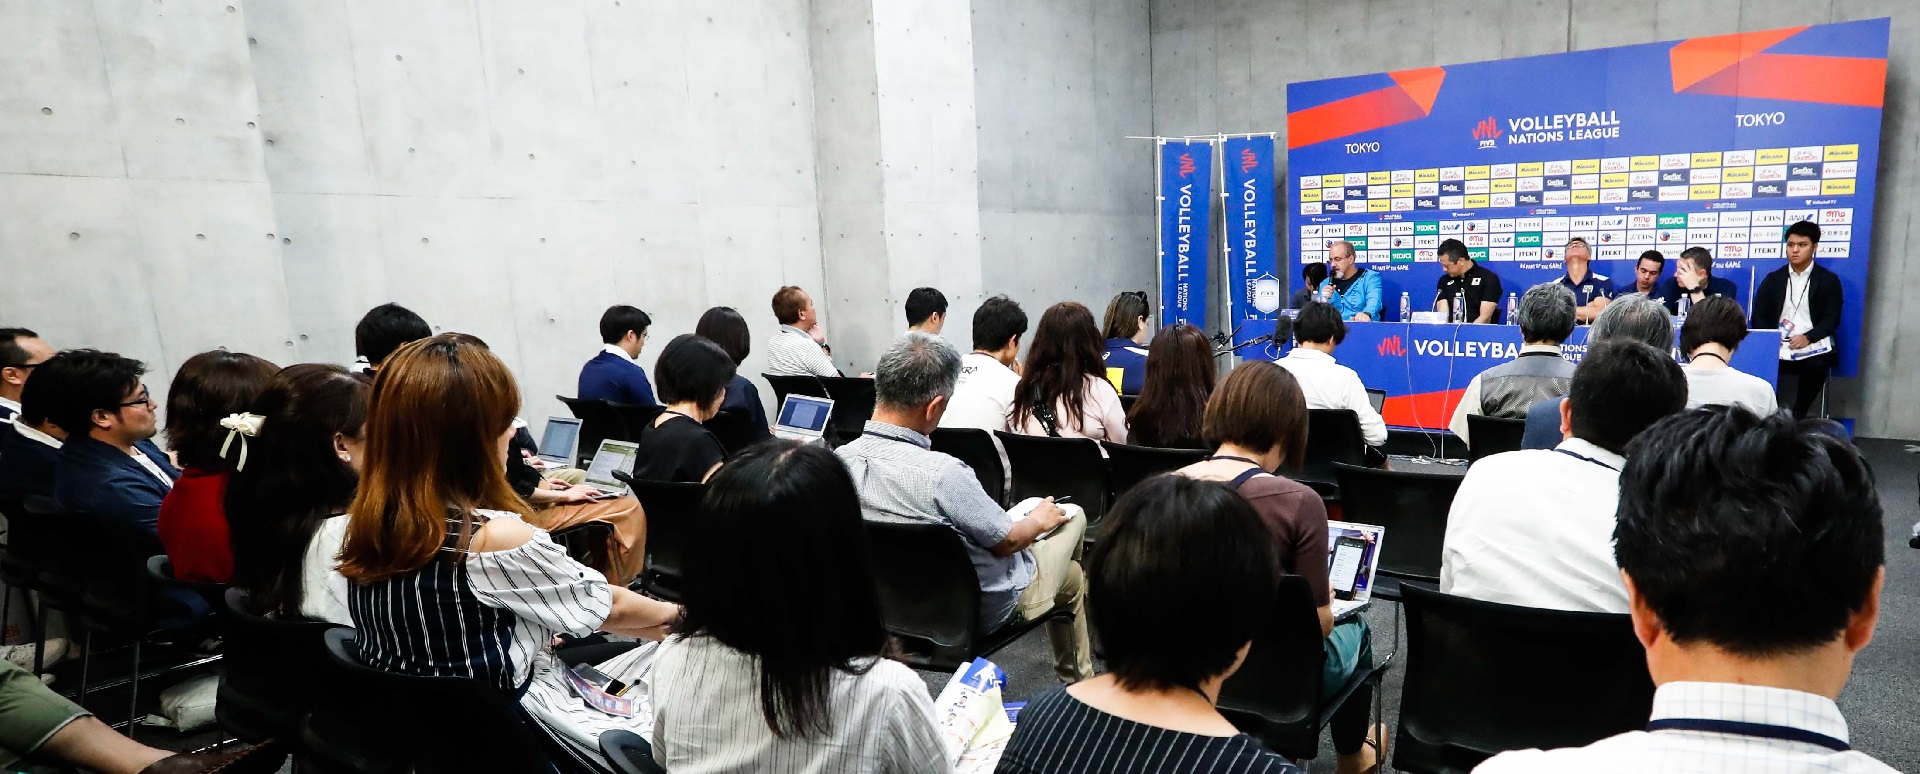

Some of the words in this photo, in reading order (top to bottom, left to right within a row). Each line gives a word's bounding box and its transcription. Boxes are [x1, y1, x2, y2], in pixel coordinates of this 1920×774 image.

[1472, 116, 1503, 140] VNL
[1508, 110, 1620, 132] VOLLEYBALL
[1735, 112, 1785, 127] TOKYO
[1508, 130, 1564, 145] NATIONS
[1569, 127, 1620, 140] LEAGUE
[1345, 142, 1380, 154] TOKYO
[1178, 184, 1192, 281] VOLLEYBALL
[1244, 179, 1257, 277] VOLLEYBALL
[1378, 335, 1407, 356] VNL
[1414, 340, 1524, 358] VOLLEYBA
[1560, 344, 1587, 353] TIONS
